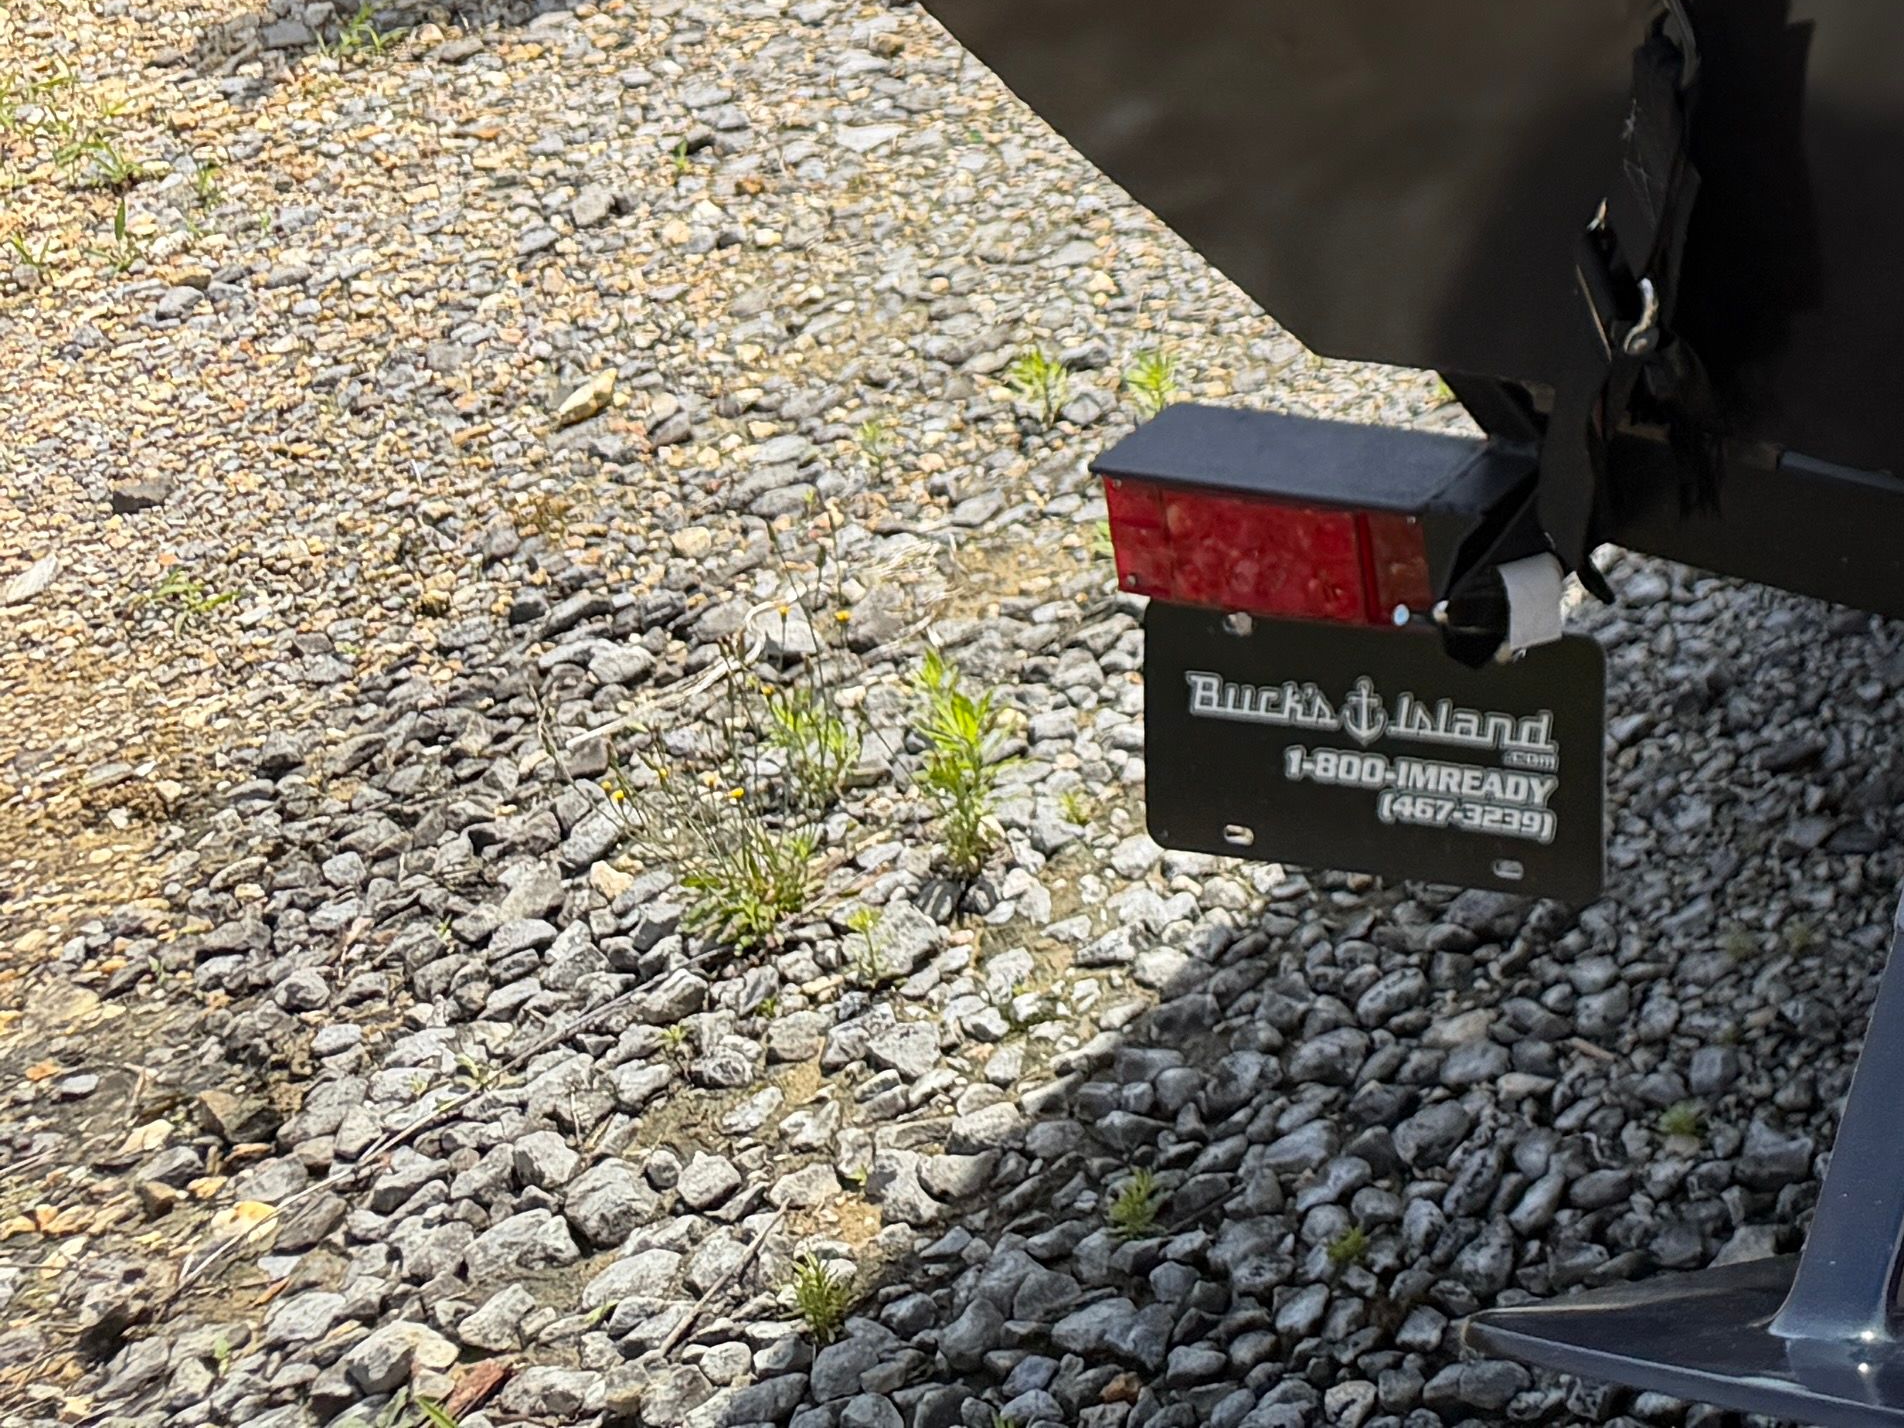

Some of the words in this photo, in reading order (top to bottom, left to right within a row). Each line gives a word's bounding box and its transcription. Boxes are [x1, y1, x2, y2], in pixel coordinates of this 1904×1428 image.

[1185, 670, 1342, 731] Buck's
[1387, 692, 1558, 752] Island
[1285, 745, 1558, 809] 1-800-IMREADY
[1379, 790, 1557, 843] (467-3239)
